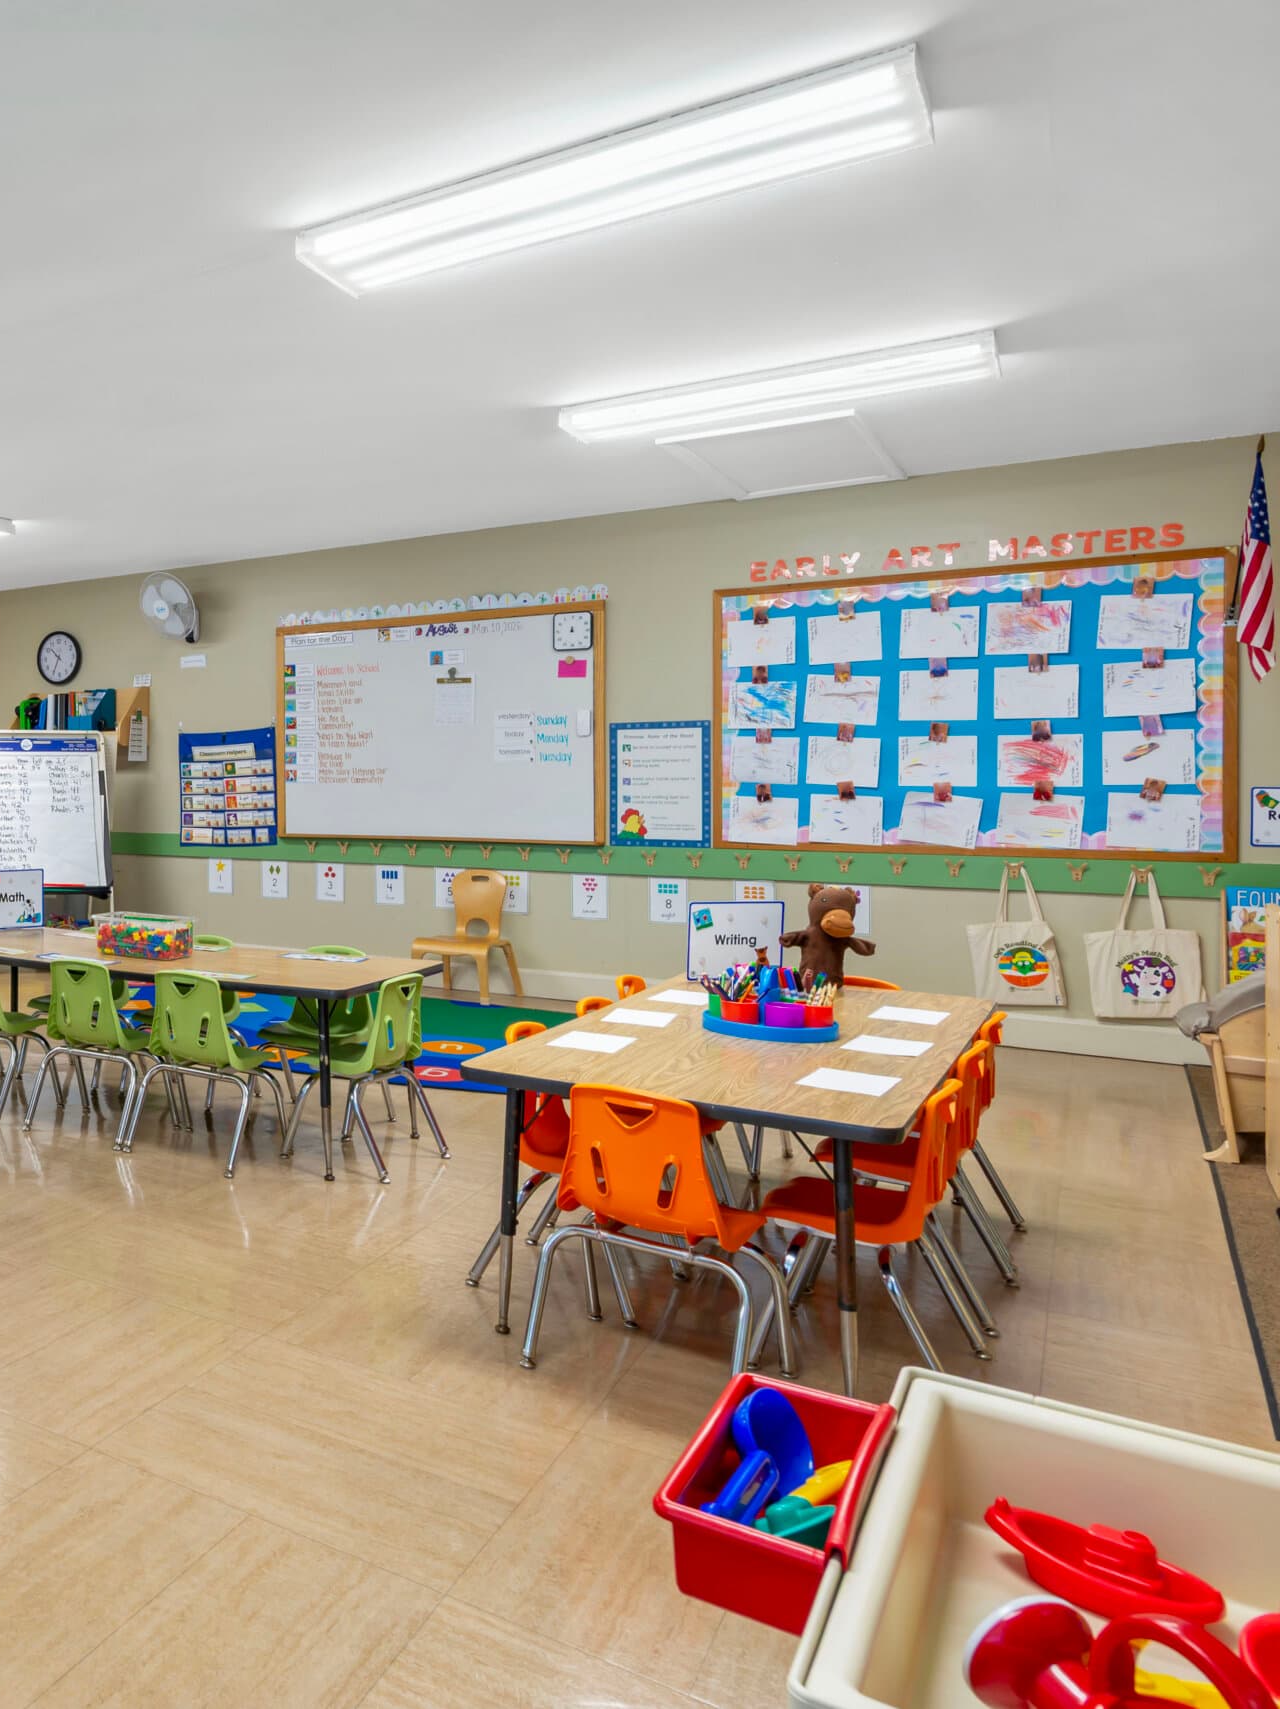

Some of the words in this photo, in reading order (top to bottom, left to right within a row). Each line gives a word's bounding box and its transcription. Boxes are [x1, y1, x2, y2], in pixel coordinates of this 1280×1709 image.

[750, 552, 860, 583] EARLY
[881, 542, 960, 571] ART
[987, 522, 1185, 562] MASTERS
[425, 623, 459, 637] August
[536, 714, 568, 728] Sunday
[536, 732, 569, 746] Monday
[272, 878, 279, 888] 2
[327, 880, 333, 891] 3
[386, 882, 393, 893] 4
[0, 891, 25, 903] Math
[509, 890, 515, 900] 6
[586, 894, 593, 905] 7
[665, 898, 672, 910] 8
[714, 932, 758, 949] Writing
